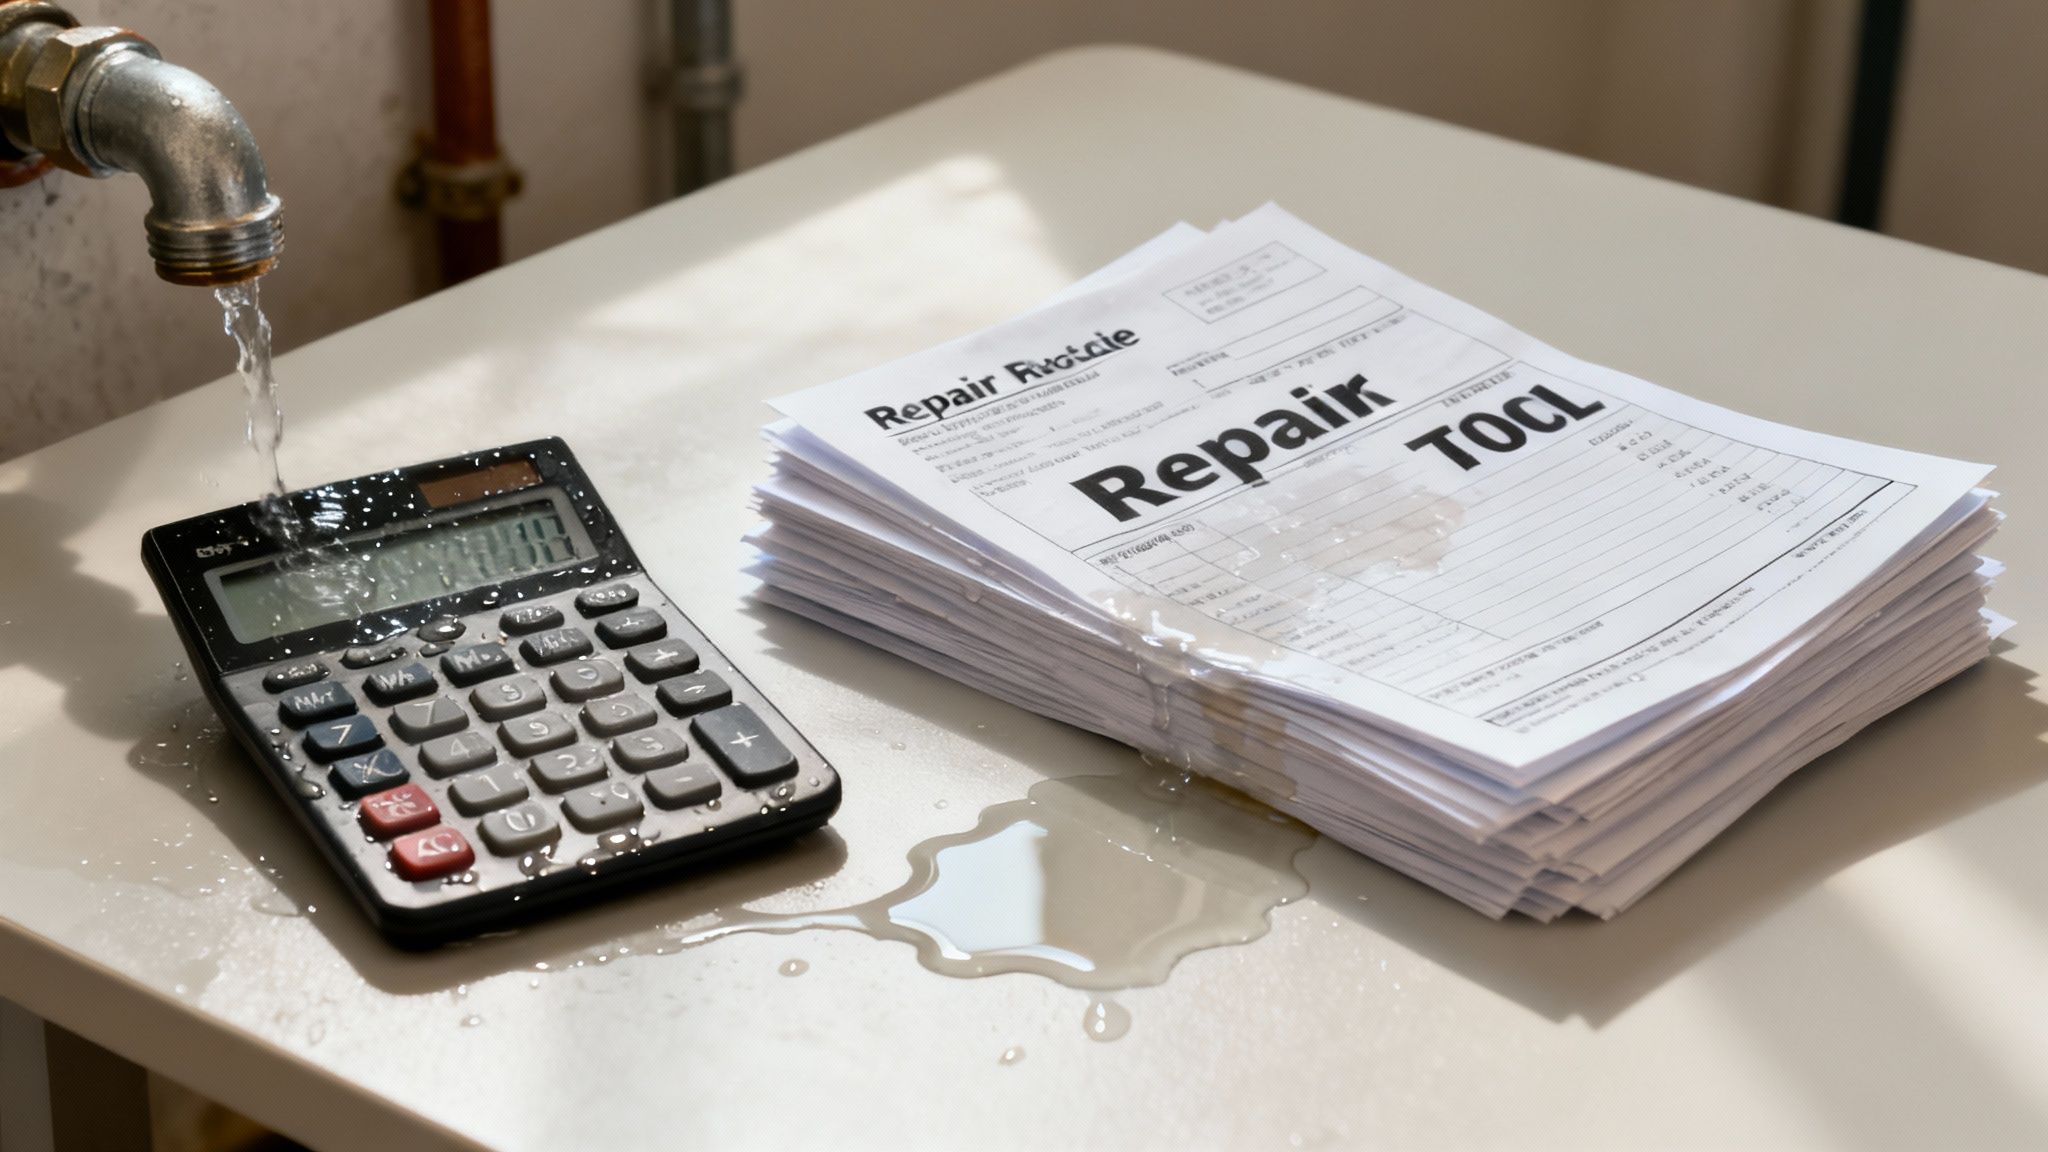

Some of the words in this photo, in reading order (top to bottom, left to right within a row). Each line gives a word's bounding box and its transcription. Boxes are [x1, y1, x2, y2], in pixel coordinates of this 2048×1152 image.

[864, 375, 999, 431] Repair
[1404, 384, 1606, 471] TOCL
[1069, 373, 1398, 523] Repair
